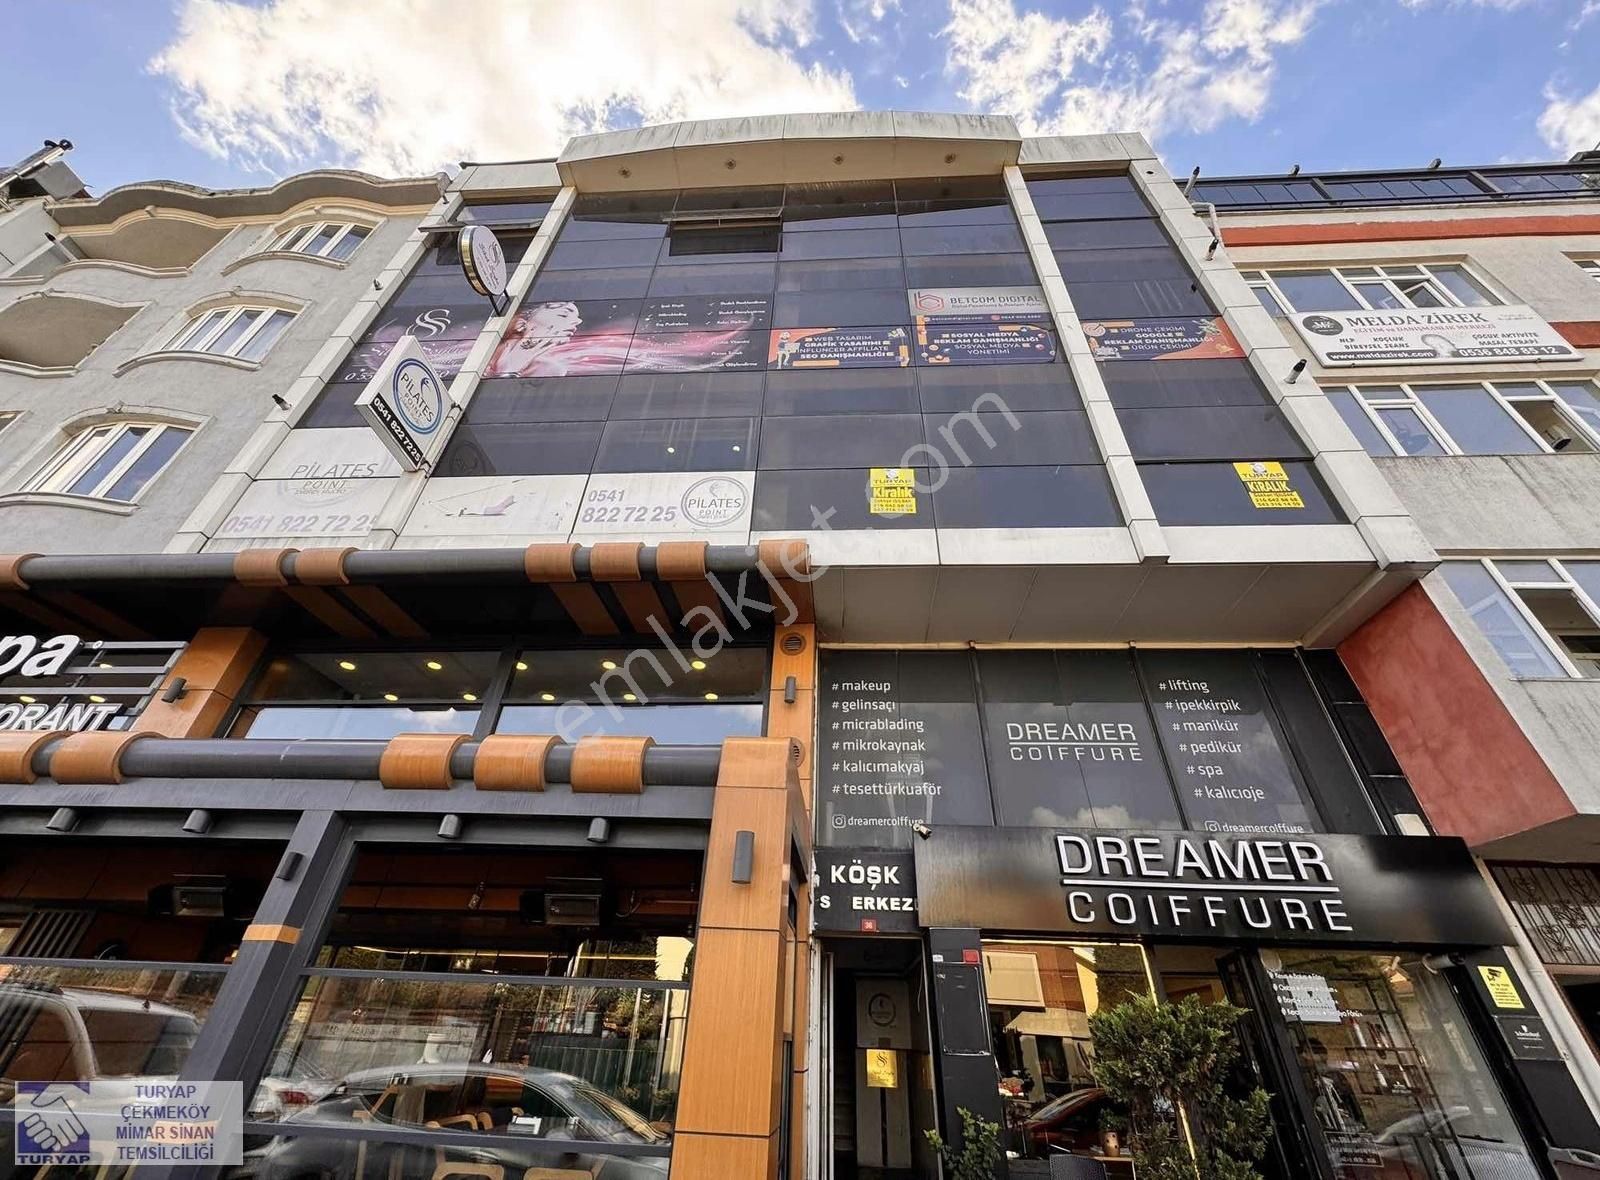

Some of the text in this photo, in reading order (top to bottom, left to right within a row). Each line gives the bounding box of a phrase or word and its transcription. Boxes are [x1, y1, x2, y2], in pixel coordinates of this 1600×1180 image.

[998, 295, 1041, 303] DIGITAL
[1345, 314, 1420, 327] MELDA
[1420, 311, 1489, 325] ZİREK
[1330, 351, 1434, 360] www.meldazirek.com
[1459, 349, 1490, 357] 0536
[1541, 346, 1559, 354] 12
[401, 372, 435, 422] PİLATES
[373, 398, 392, 421] 0541
[290, 461, 379, 479] PİLATES
[302, 480, 348, 489] POINT
[588, 489, 625, 502] 0541
[688, 496, 742, 509] PİLATES
[222, 515, 274, 533] 0541
[277, 515, 319, 532] 822
[1006, 723, 1137, 741] DREAMER
[1009, 745, 1143, 761] COIFFURE
[1056, 835, 1334, 881] DREAMER
[830, 859, 900, 891] KÖŞK
[1068, 891, 1353, 931] COIFFURE
